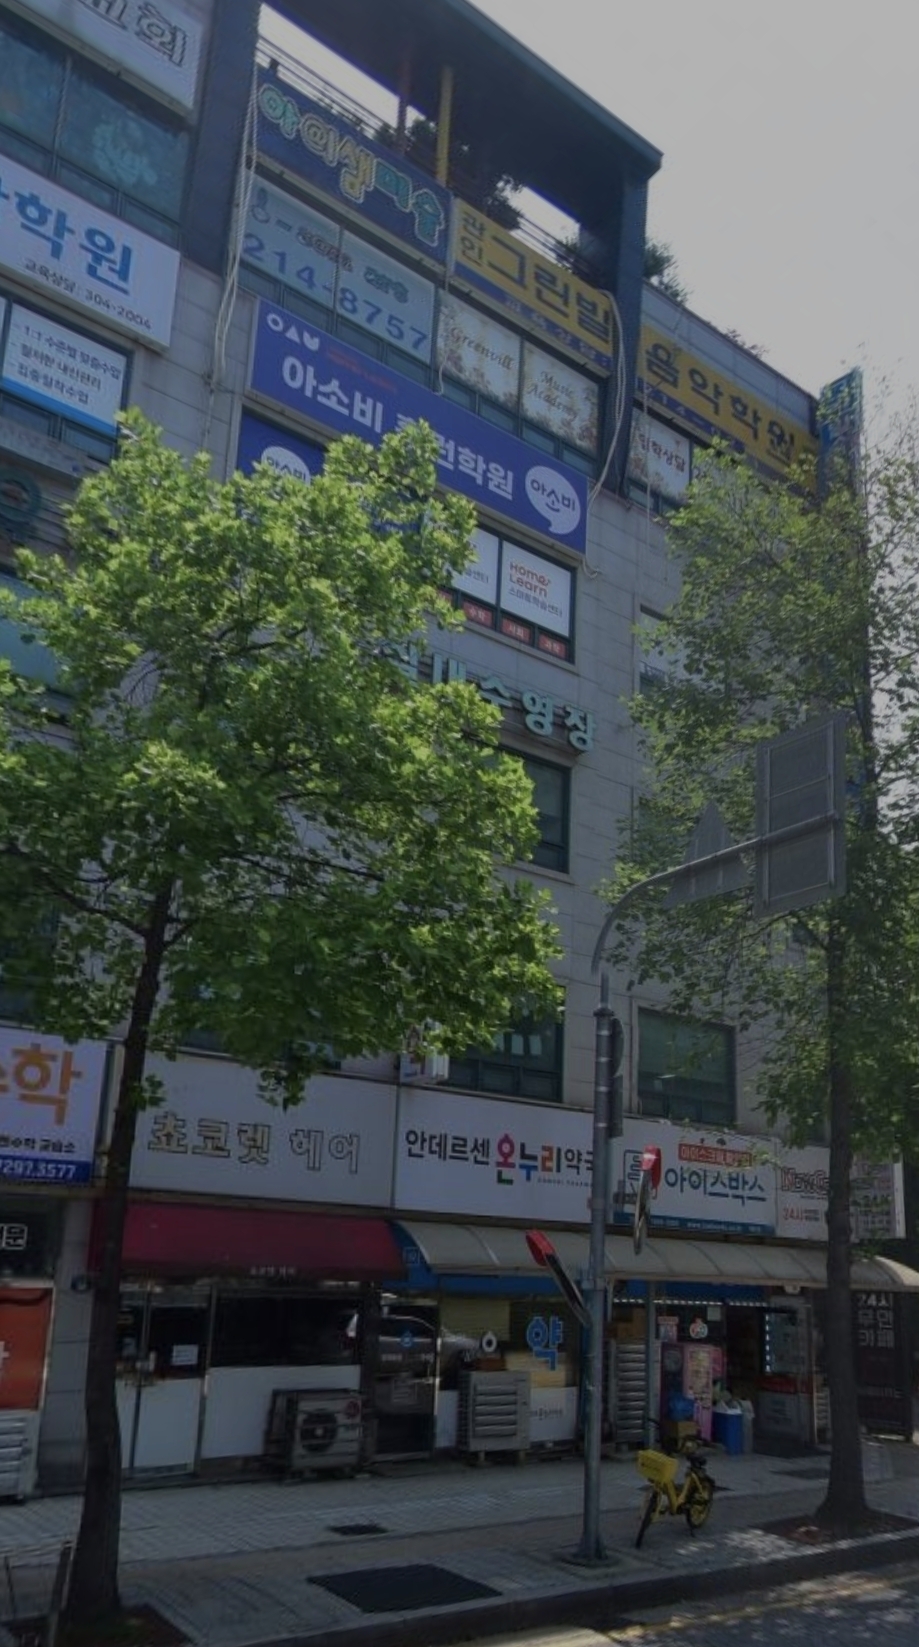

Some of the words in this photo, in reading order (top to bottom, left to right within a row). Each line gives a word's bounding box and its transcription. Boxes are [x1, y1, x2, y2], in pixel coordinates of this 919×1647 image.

[0, 178, 133, 296] 학원
[488, 234, 611, 345] 그린빌
[282, 355, 385, 434] 아소비
[645, 342, 796, 468] 음악학원
[148, 1111, 271, 1165] 초코렛
[289, 1128, 361, 1174] 헤어
[405, 1129, 490, 1166] 안데르센
[664, 1166, 767, 1207] 아이스박스
[526, 1315, 564, 1371] 약
